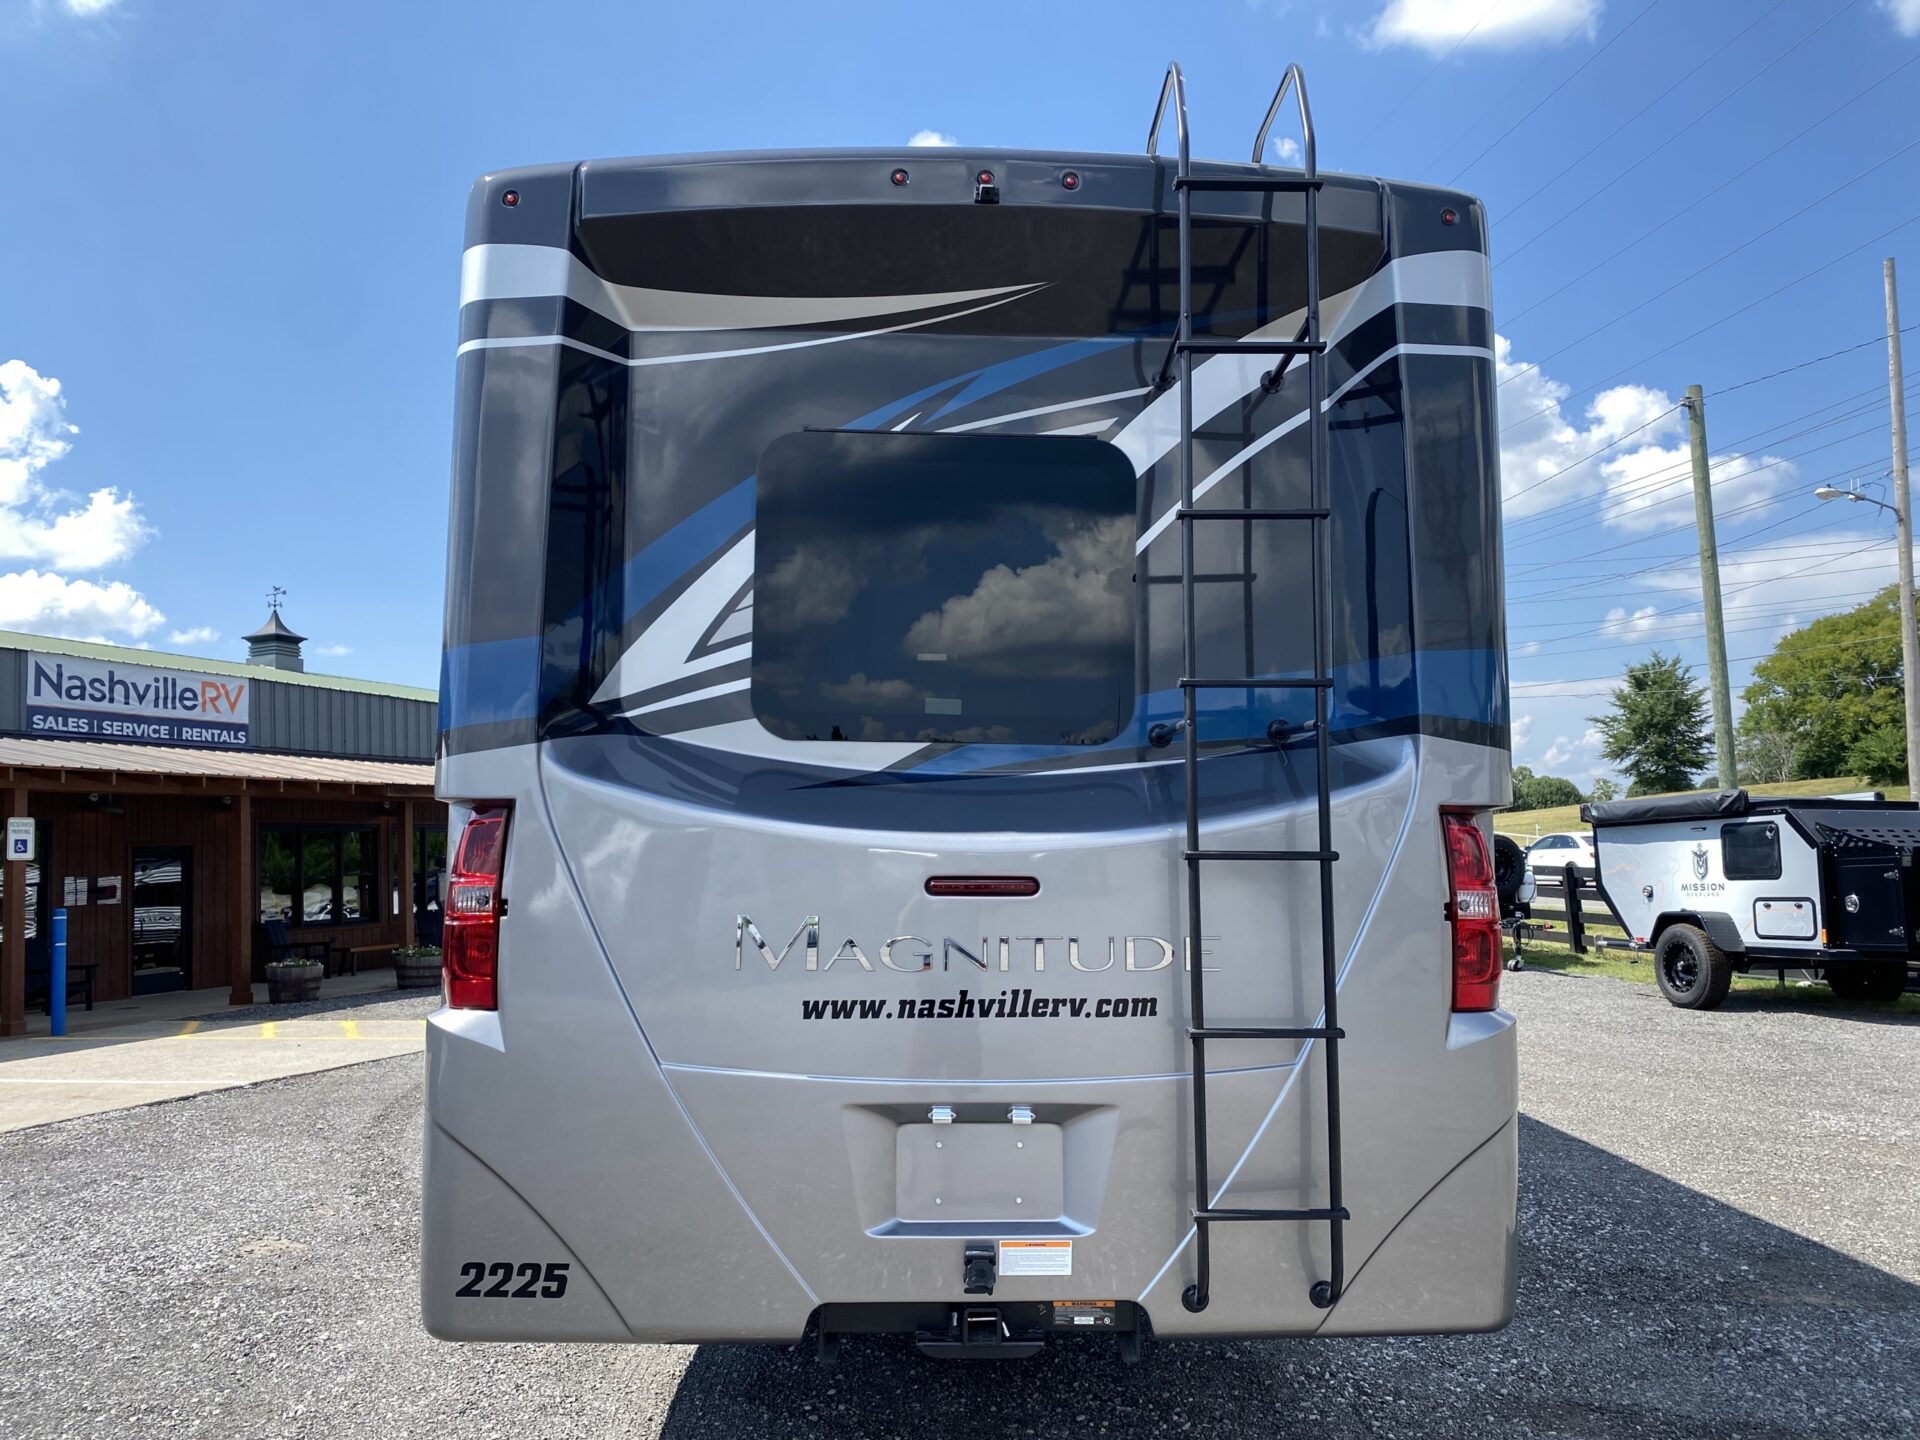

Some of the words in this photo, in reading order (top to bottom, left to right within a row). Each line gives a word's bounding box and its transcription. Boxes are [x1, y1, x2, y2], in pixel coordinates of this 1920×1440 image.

[34, 660, 245, 715] NashvilleRV
[32, 714, 89, 733] SALES
[102, 720, 170, 739] SERVICE
[182, 726, 247, 744] RENTALS
[1681, 883, 1725, 892] MISSION
[802, 989, 1158, 1020] www.nashvillerv.com
[455, 1261, 571, 1299] 2225
